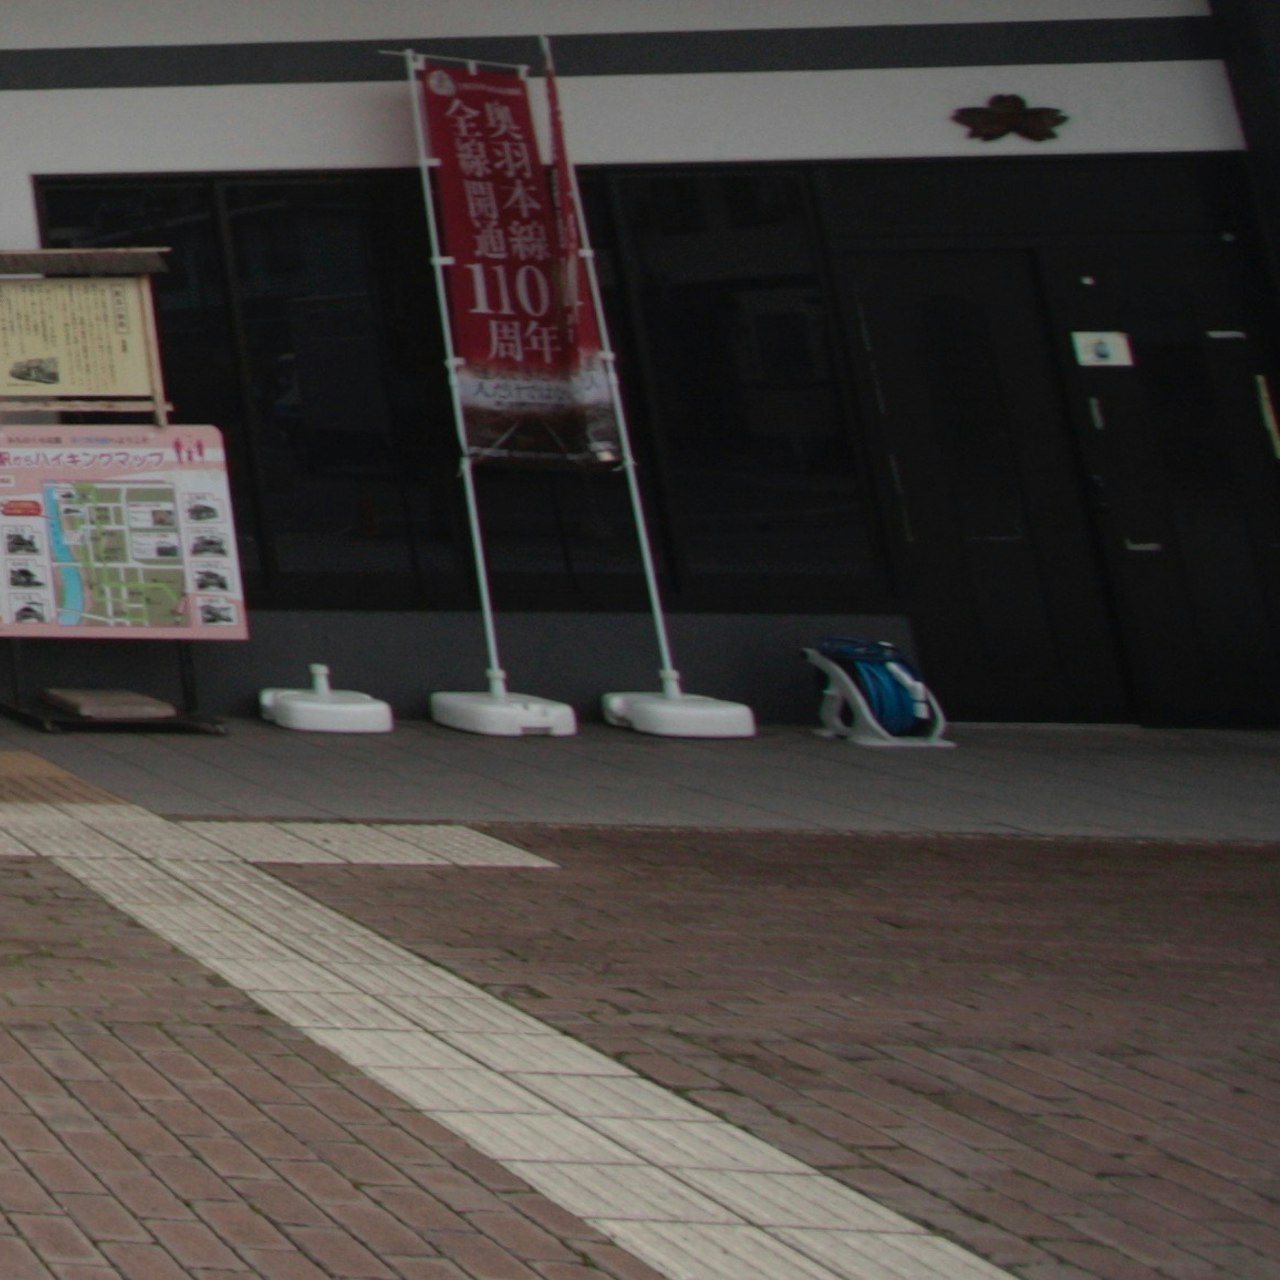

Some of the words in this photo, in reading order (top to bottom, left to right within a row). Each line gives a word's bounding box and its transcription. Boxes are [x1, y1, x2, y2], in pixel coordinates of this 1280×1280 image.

[445, 98, 509, 260] 全線開通
[485, 101, 552, 261] 奥羽本線
[464, 263, 551, 317] 110
[488, 319, 562, 364] 周年
